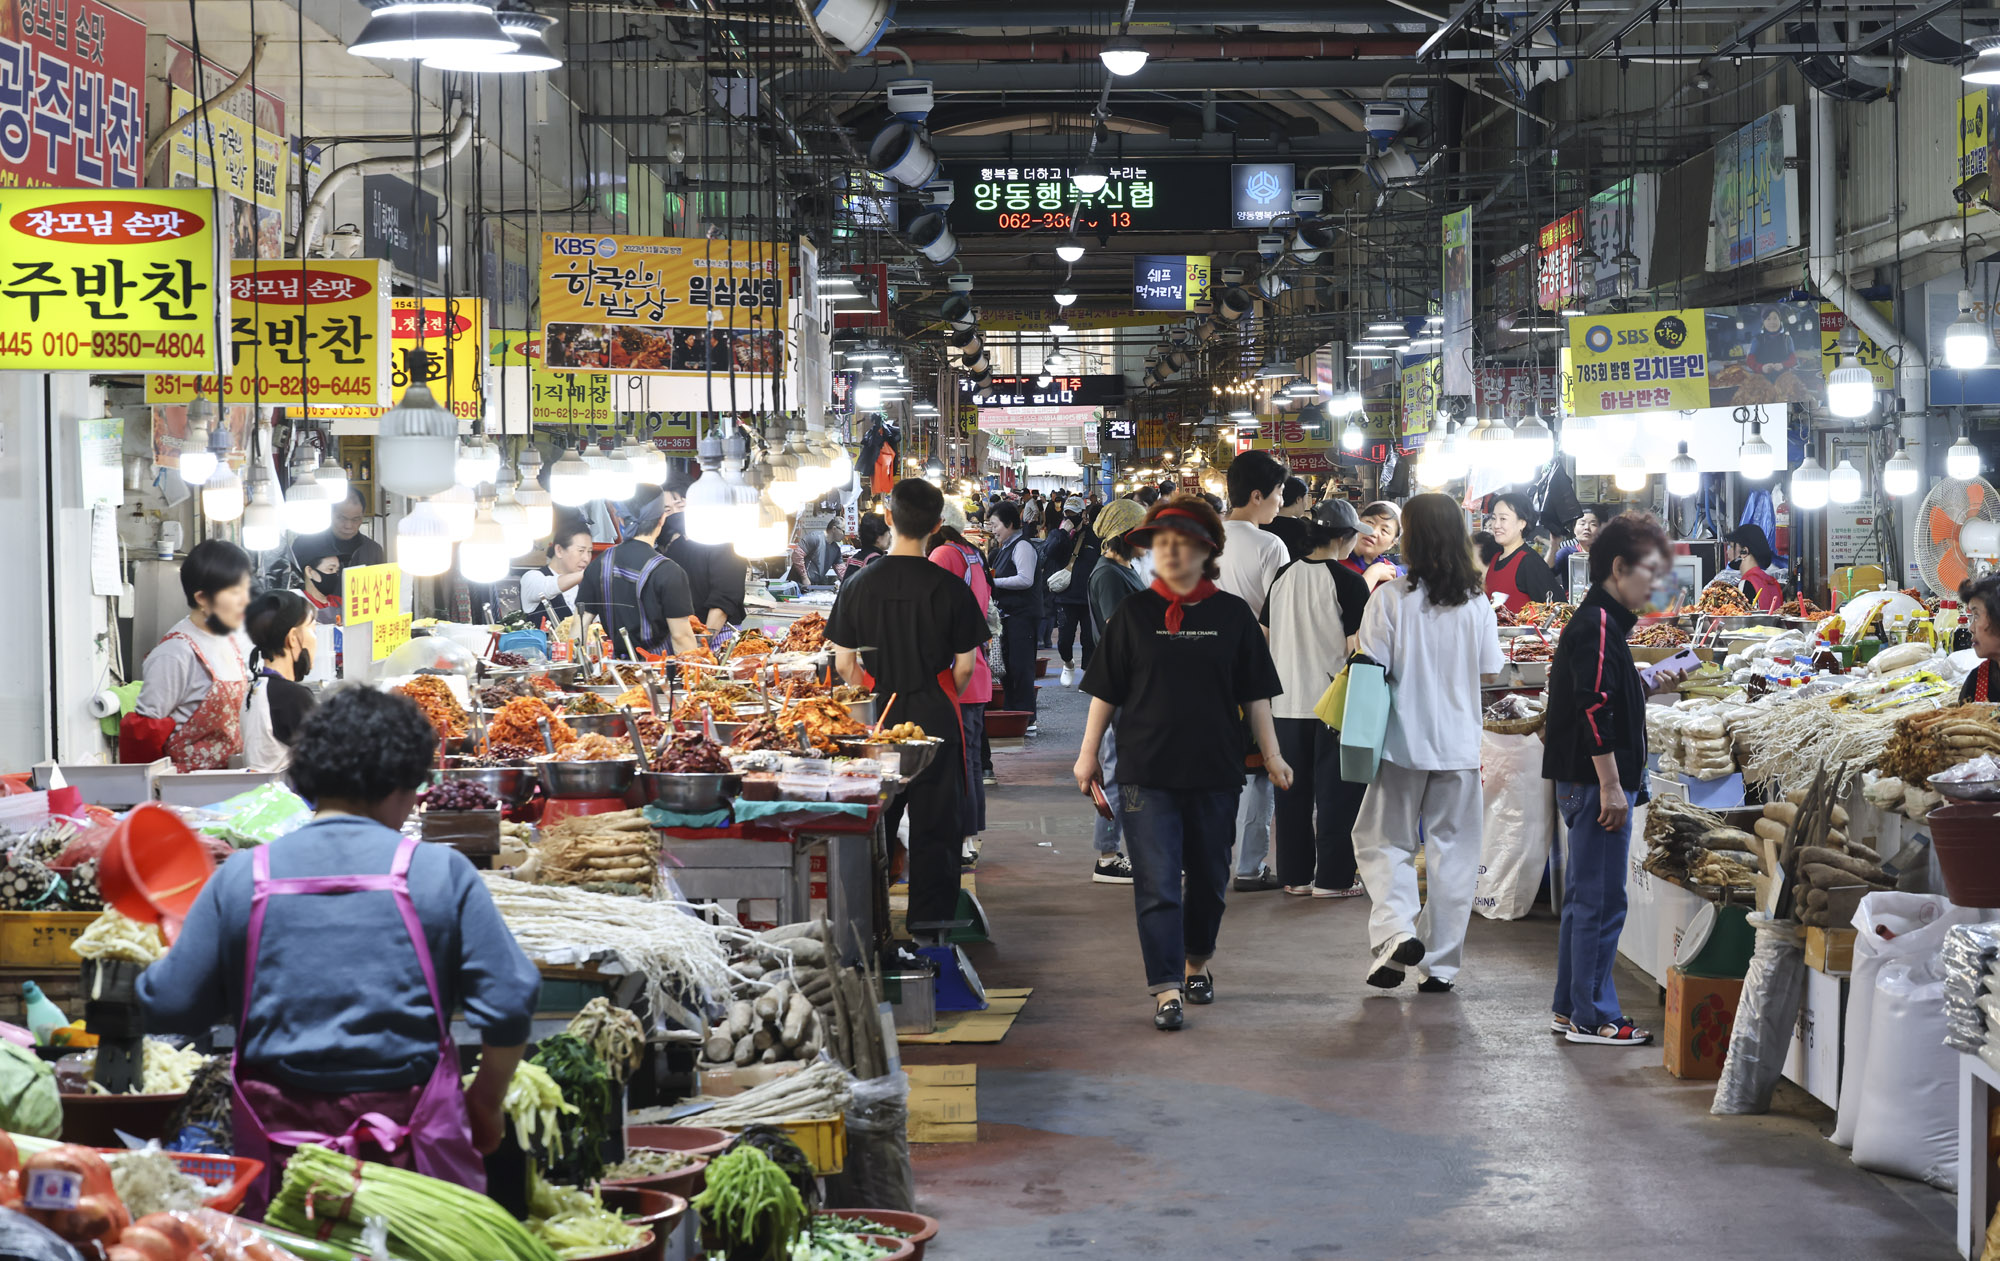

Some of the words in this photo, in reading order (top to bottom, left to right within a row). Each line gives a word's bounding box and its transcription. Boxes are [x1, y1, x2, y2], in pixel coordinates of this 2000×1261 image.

[75, 5, 106, 66] 손맛
[0, 38, 142, 188] 광주반찬
[981, 168, 1019, 181] 행복을
[1023, 168, 1061, 180] 더하고
[1109, 167, 1147, 179] 누리는
[25, 210, 113, 237] 장모님
[122, 211, 185, 237] 손맛
[554, 238, 596, 255] KBS
[551, 259, 662, 307] 한국인의
[1147, 268, 1172, 282] 쉐프
[0, 258, 207, 323] 주반찬
[230, 277, 298, 299] 장모님
[307, 277, 356, 299] 손맛
[689, 276, 783, 308] 일심상회
[1136, 285, 1183, 300] 먹거리길
[600, 288, 681, 323] 밥상
[42, 332, 205, 358] 010-9350-4804
[1617, 328, 1649, 346] SBS
[1576, 362, 1608, 382] 785회
[1610, 361, 1631, 381] 방영
[1633, 354, 1705, 381] 김치달인
[533, 383, 610, 404] 직매장
[1601, 387, 1671, 410] 하남반찬
[1260, 420, 1306, 443] 각종
[351, 570, 395, 617] 일심상회
[1474, 896, 1496, 907] CHINA
